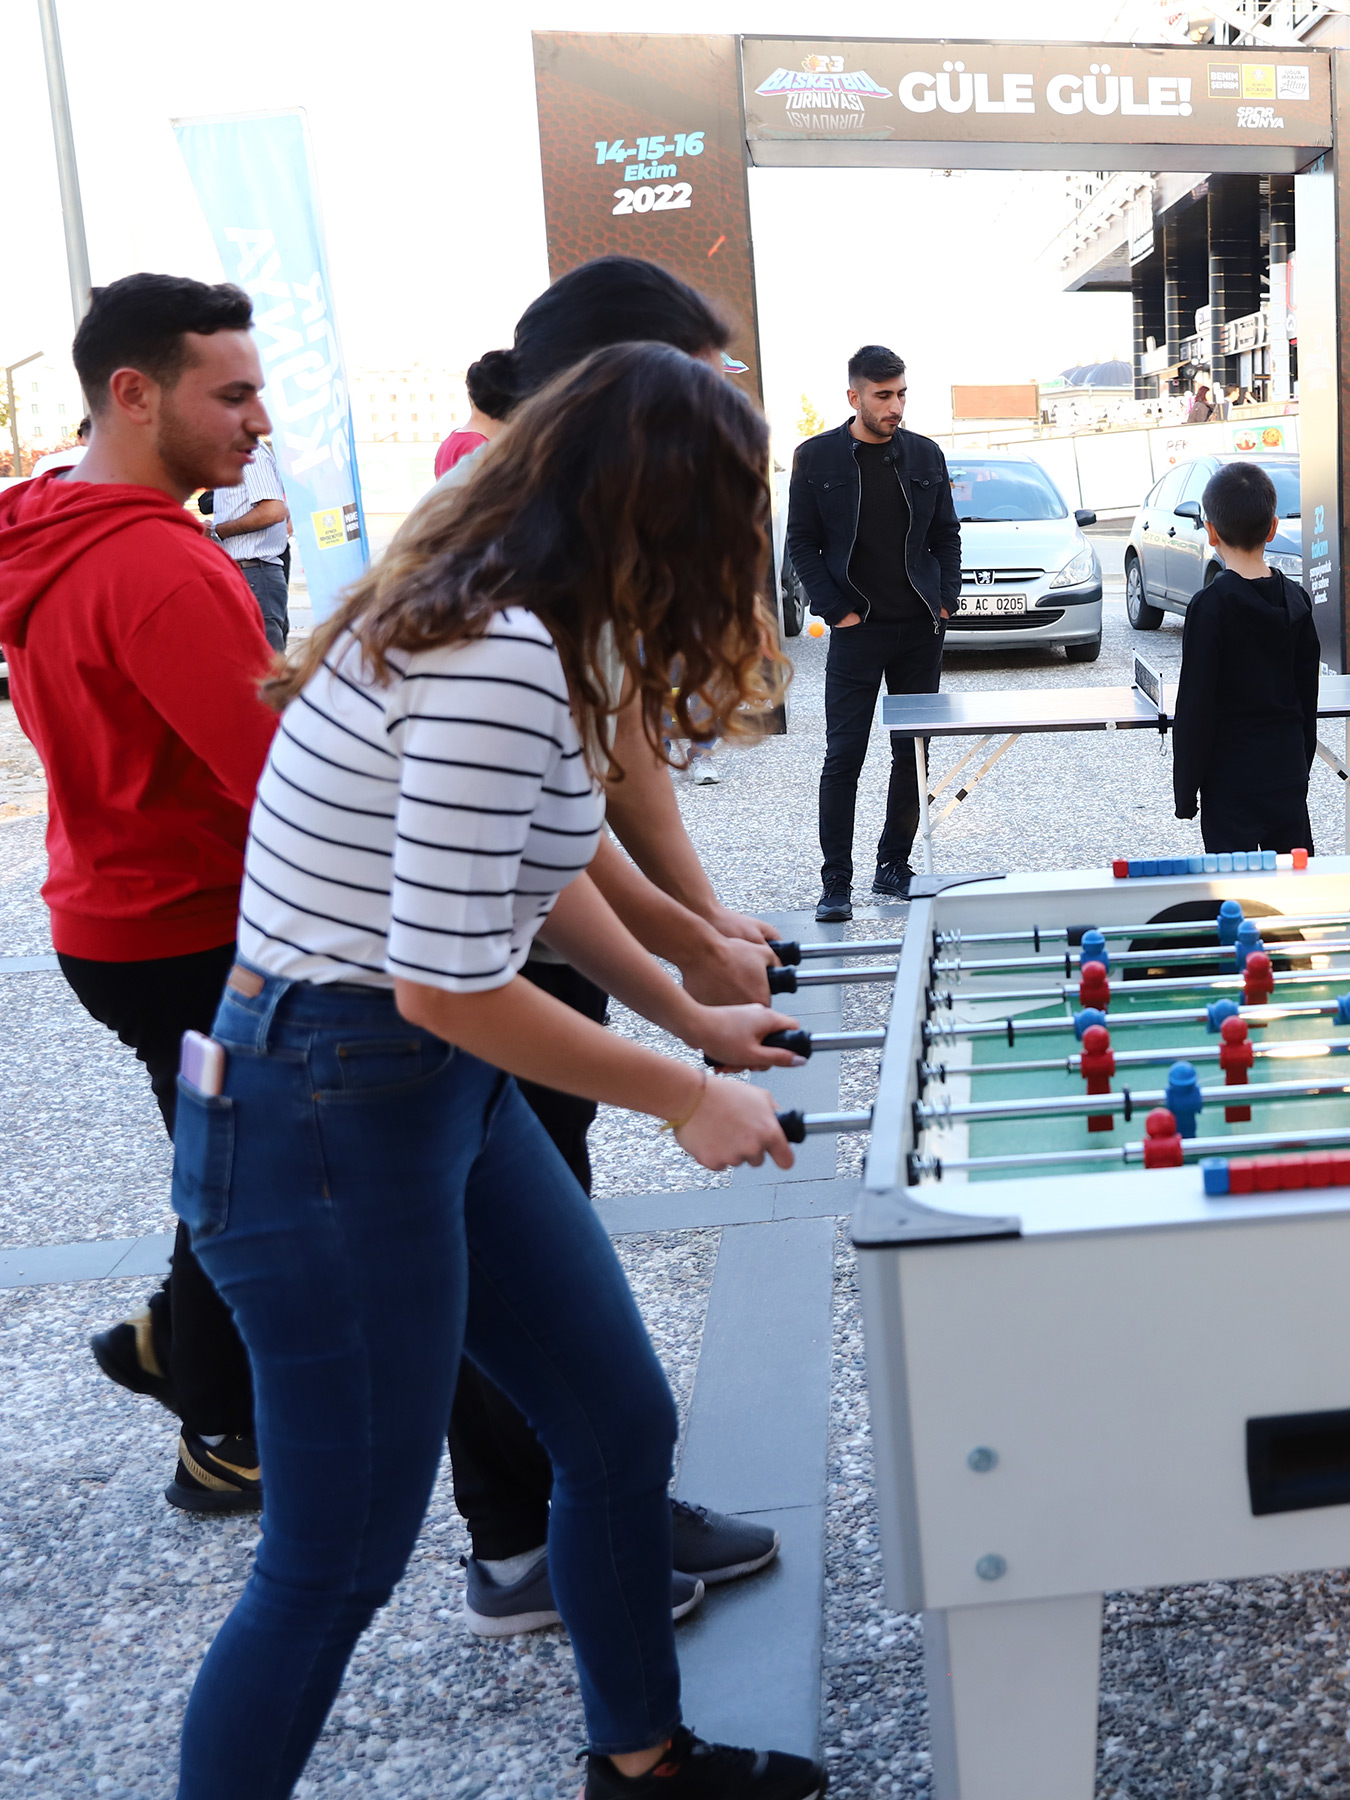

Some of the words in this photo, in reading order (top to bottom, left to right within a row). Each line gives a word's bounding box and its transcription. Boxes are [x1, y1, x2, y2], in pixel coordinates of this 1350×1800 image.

[755, 67, 893, 99] BASKETBOL
[898, 60, 1036, 114] GÜLE
[1046, 63, 1193, 117] GÜLE!
[785, 92, 866, 111] TURNUVASI
[594, 131, 706, 165] 14-15-16
[623, 160, 678, 182] Ekim
[612, 182, 693, 216] 2022
[975, 598, 989, 611] AC
[996, 597, 1024, 611] 0205
